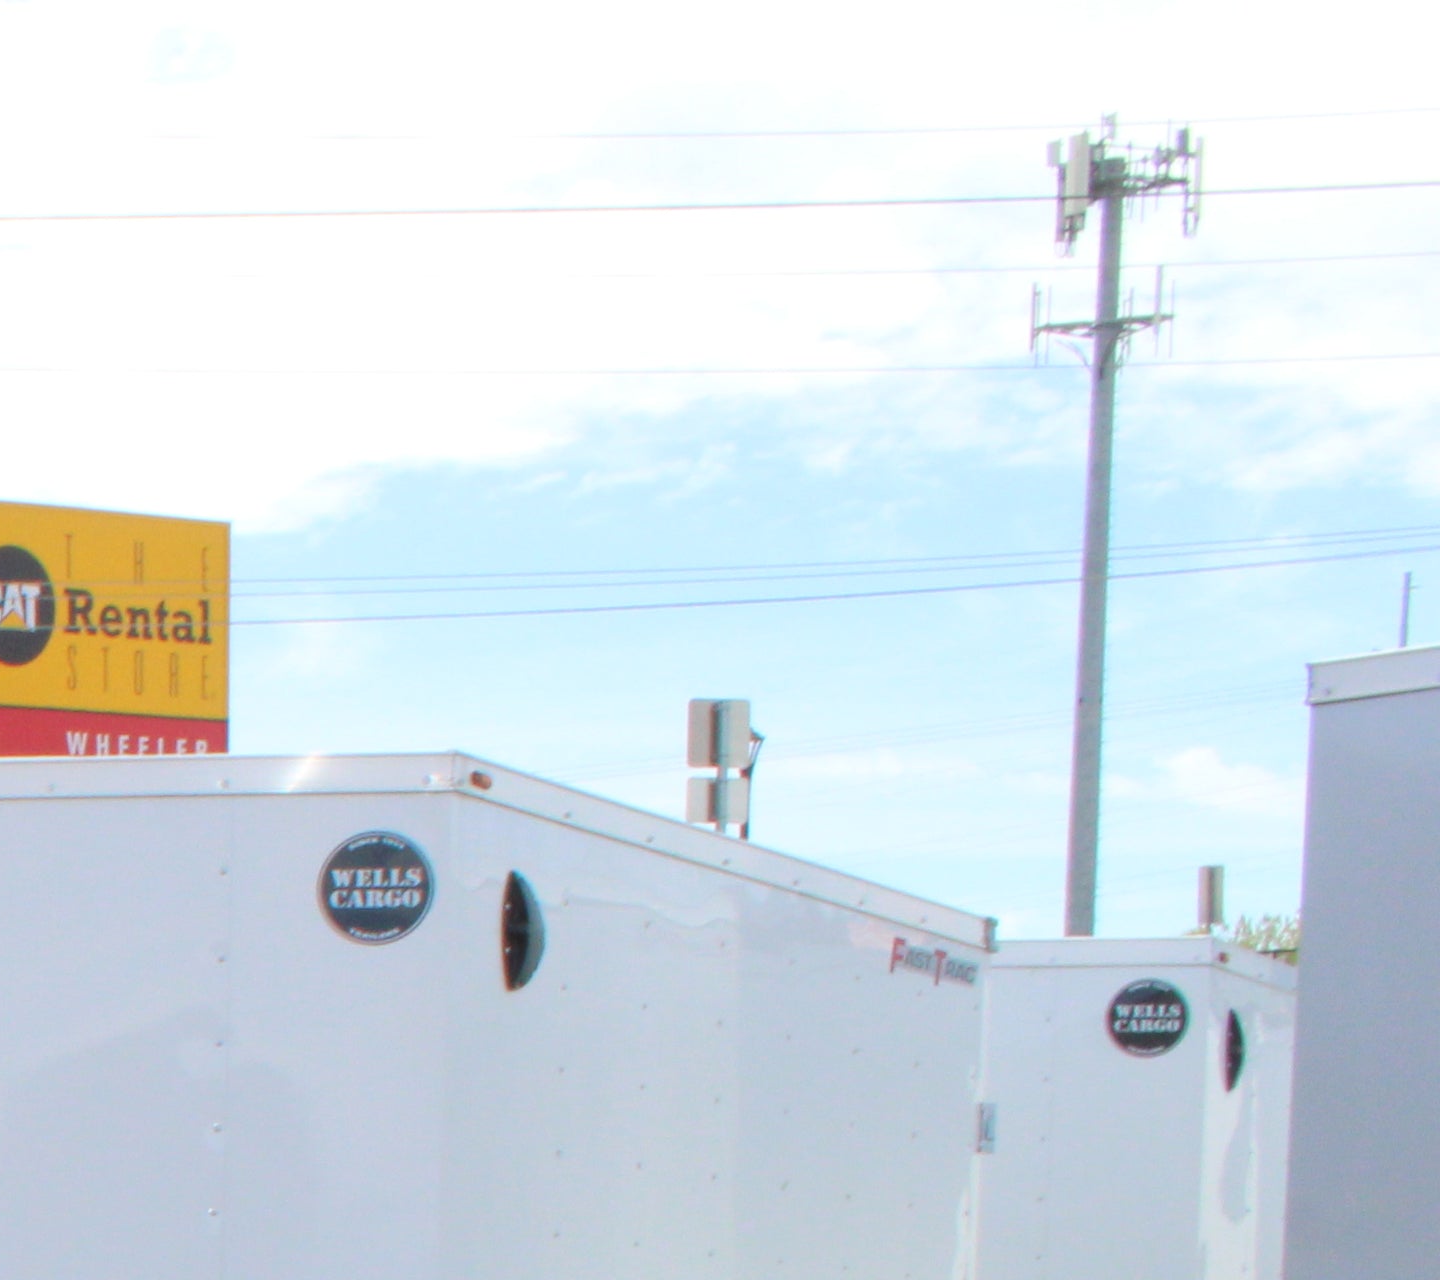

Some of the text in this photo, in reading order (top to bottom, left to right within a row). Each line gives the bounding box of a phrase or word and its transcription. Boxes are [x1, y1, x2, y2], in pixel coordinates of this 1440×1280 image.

[64, 533, 210, 593] THE
[63, 587, 213, 644] Rental
[67, 645, 210, 700] STORE
[330, 867, 423, 887] WELLS
[329, 888, 424, 908] CARGO
[1113, 1003, 1181, 1018] WELLS
[1112, 1019, 1180, 1033] CARGO
